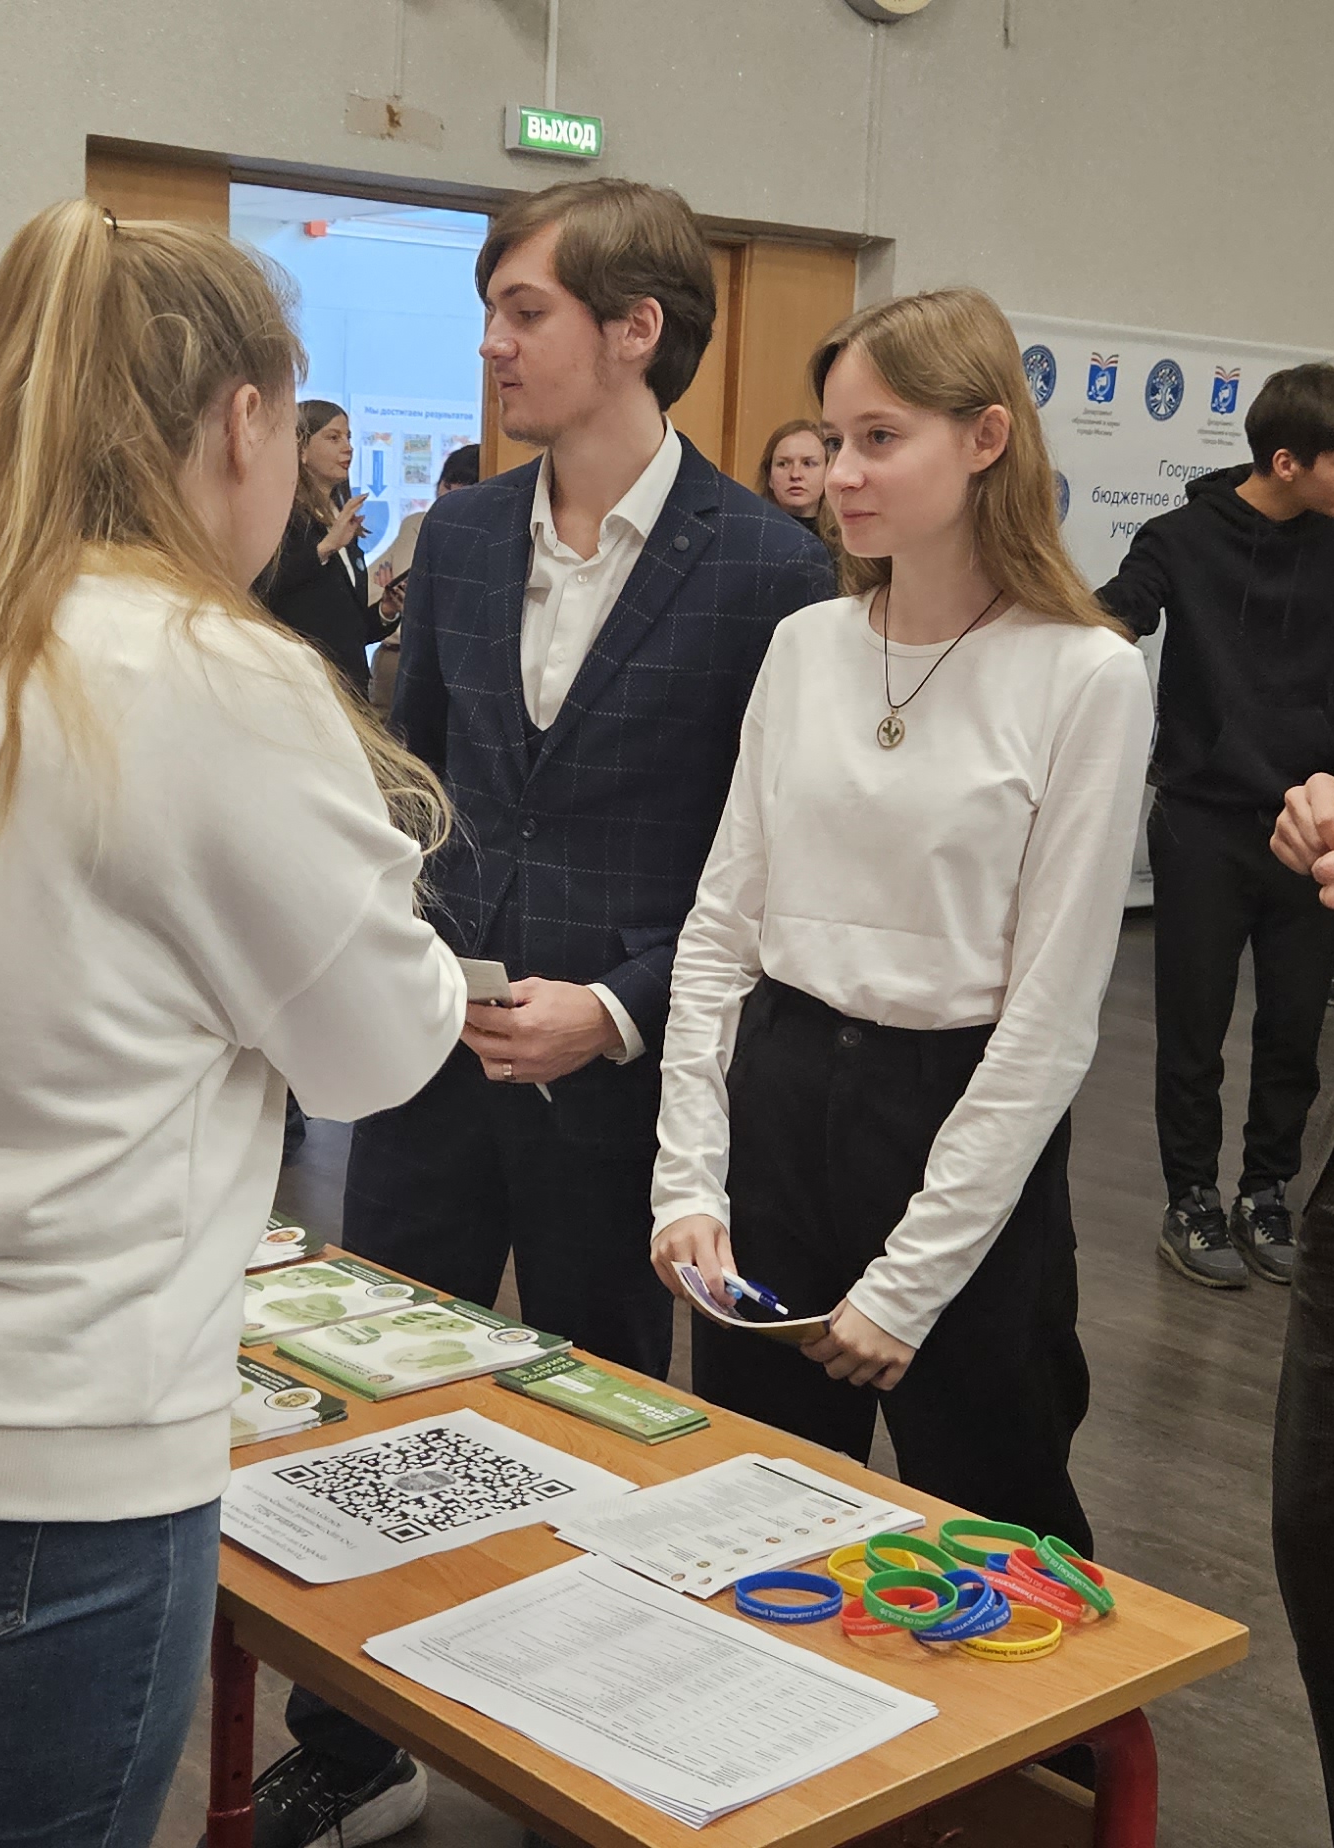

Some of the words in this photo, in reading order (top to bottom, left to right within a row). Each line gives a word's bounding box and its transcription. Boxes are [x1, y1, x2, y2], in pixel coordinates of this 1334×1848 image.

[527, 116, 597, 151] ВЫХОД
[1091, 486, 1169, 507] бюджетное
[769, 1609, 813, 1621] Университет
